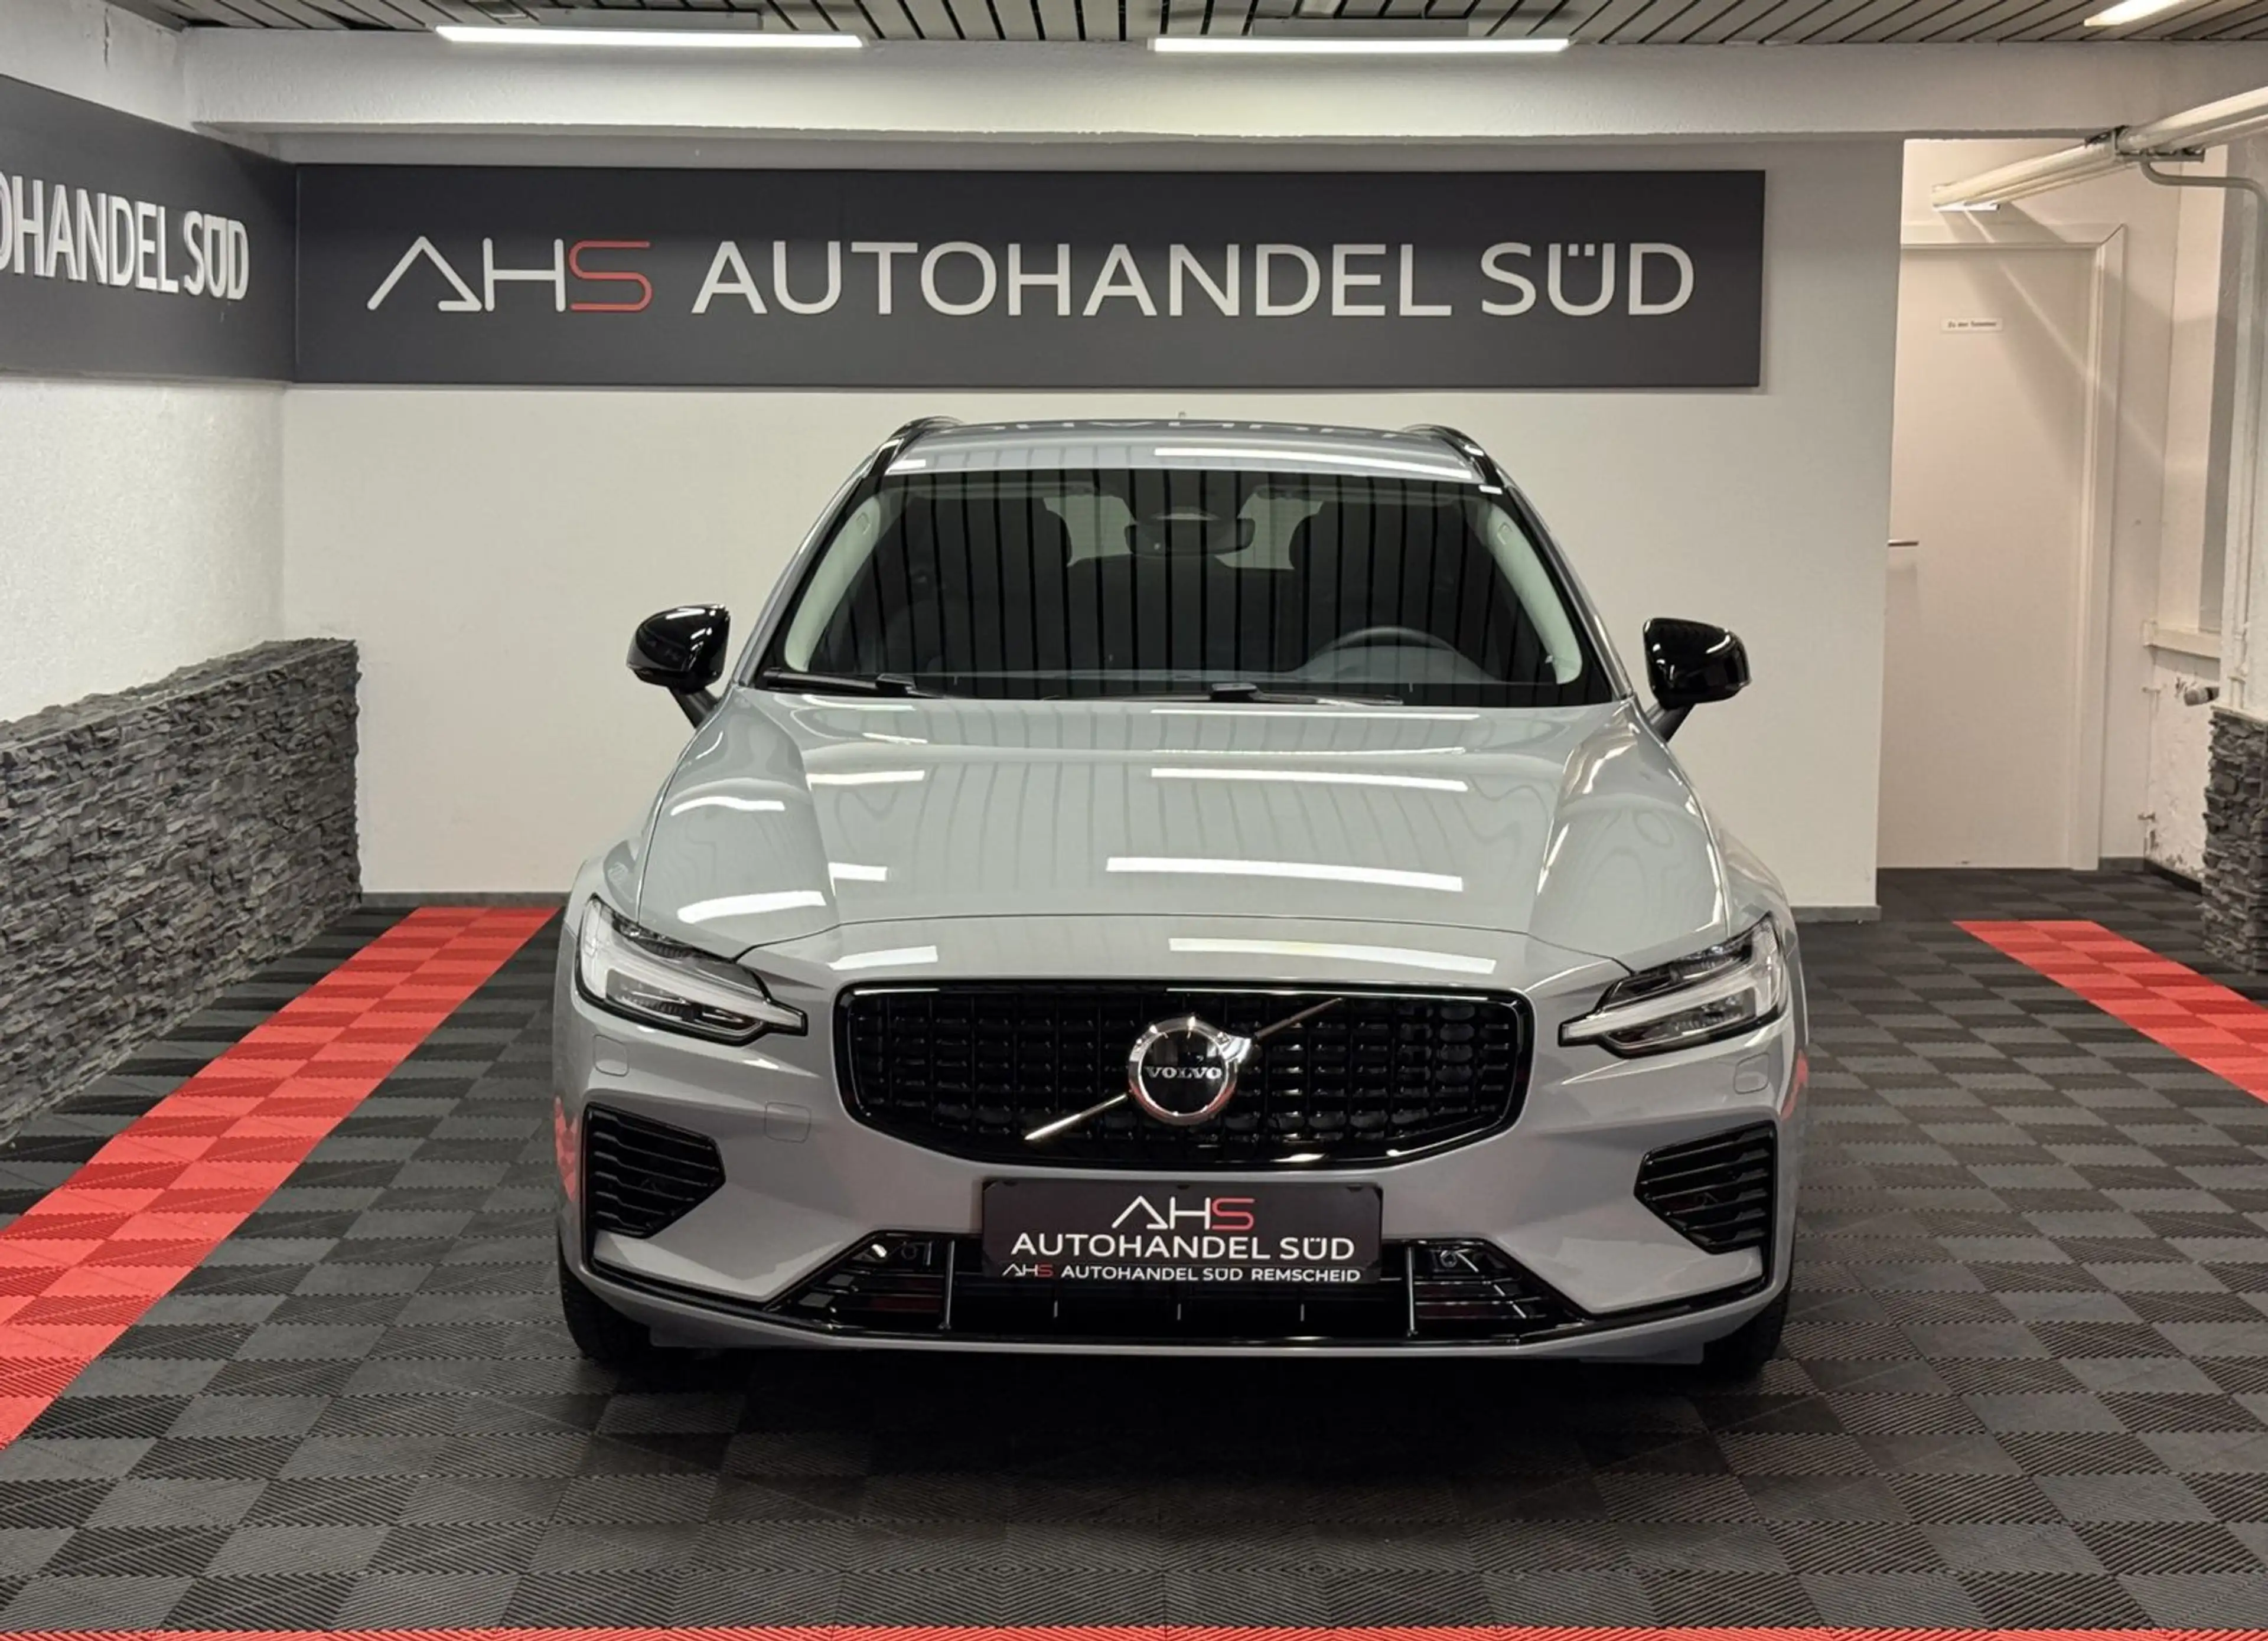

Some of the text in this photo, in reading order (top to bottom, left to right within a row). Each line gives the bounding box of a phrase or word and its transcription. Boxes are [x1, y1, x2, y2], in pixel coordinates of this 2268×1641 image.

[367, 236, 1694, 316] AHS AUTOHANDEL SÜD
[1144, 1066, 1223, 1079] VOLVO
[1111, 1195, 1255, 1231] AHS
[1011, 1233, 1355, 1261] AUTOHANDEL SÜD
[1002, 1264, 1361, 1283] AHS AUTOHANDEL SÜD REMSCHEID
